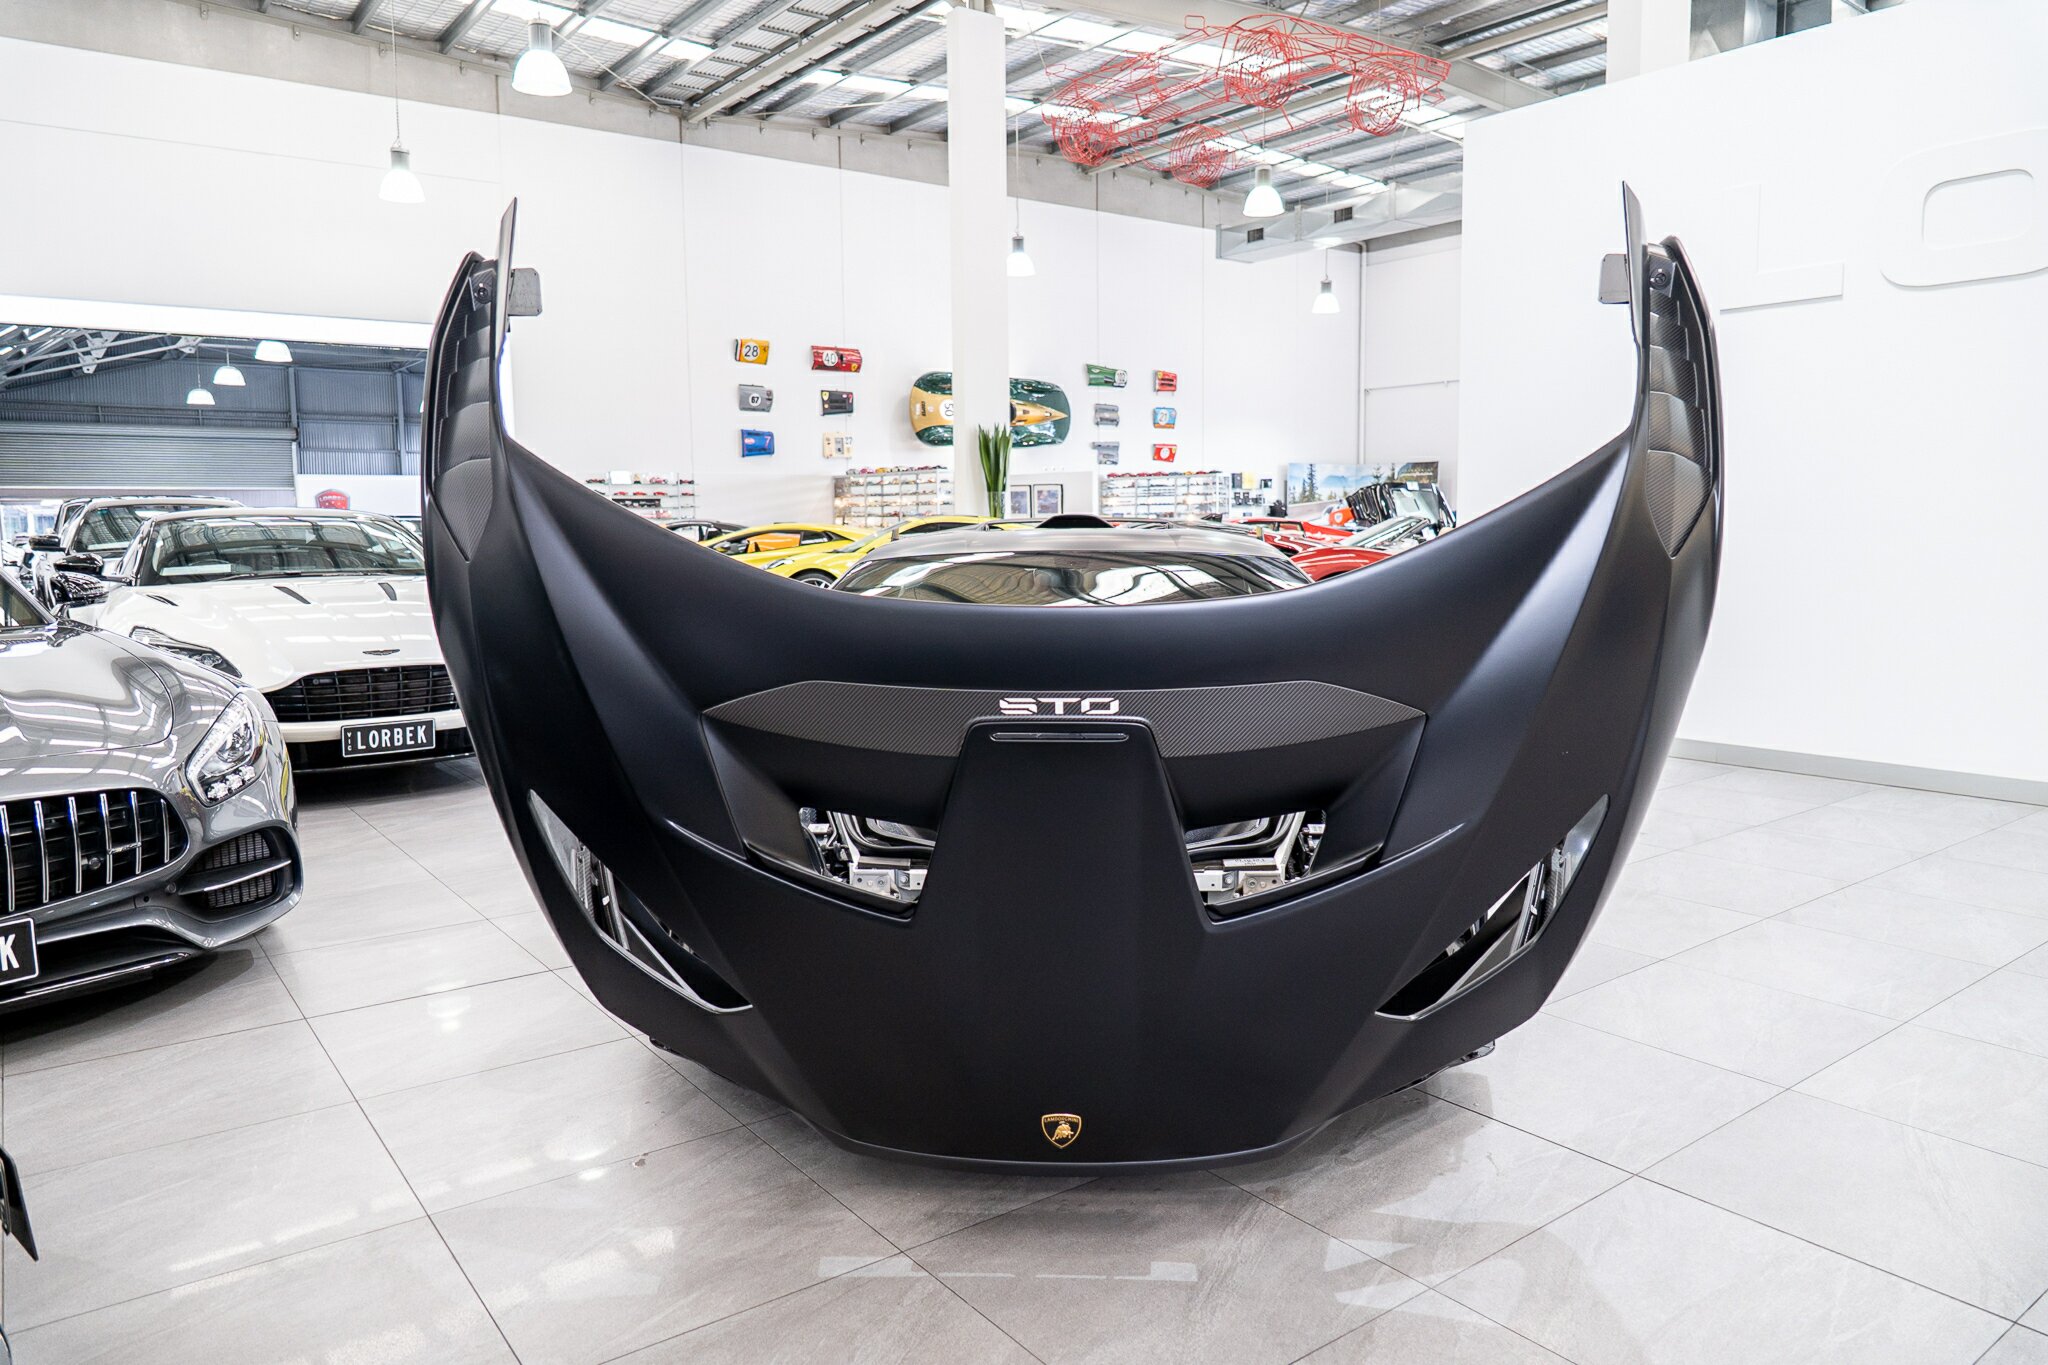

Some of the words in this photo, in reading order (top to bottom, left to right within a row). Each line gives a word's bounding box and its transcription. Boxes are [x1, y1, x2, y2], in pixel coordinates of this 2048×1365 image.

[744, 345, 759, 358] 28
[824, 353, 836, 367] 40
[944, 403, 954, 417] 50
[764, 435, 771, 448] 7
[999, 697, 1120, 715] STO
[356, 725, 427, 750] LORBEK
[0, 933, 20, 972] K
